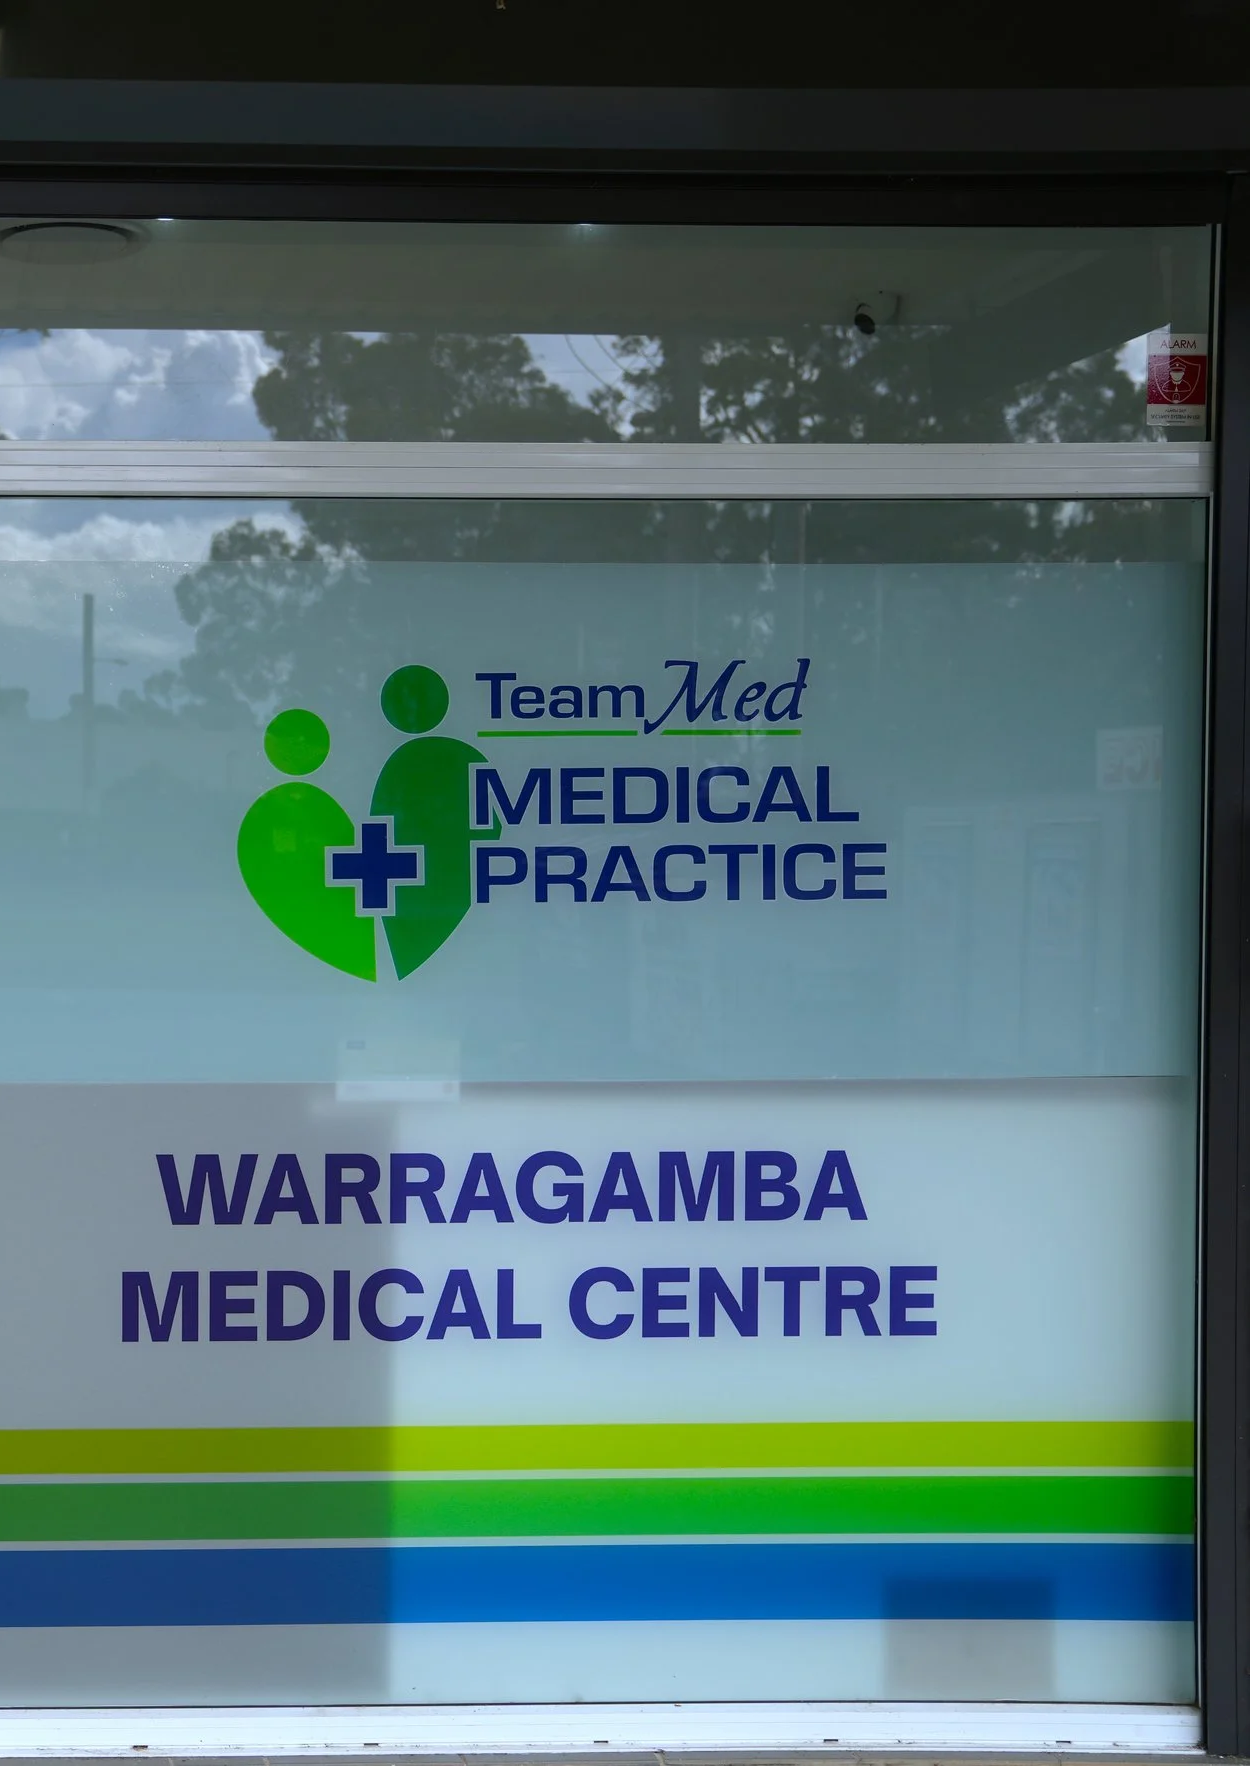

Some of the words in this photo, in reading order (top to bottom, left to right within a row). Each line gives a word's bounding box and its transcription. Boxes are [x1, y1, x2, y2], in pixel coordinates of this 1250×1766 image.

[1160, 339, 1197, 349] ALARM
[475, 765, 860, 826] MEDICAL
[476, 842, 888, 904] PRACTICE
[156, 1150, 868, 1226] WARRAGAMBA
[121, 1266, 543, 1343] MEDICAL
[567, 1264, 938, 1338] CENTRE
